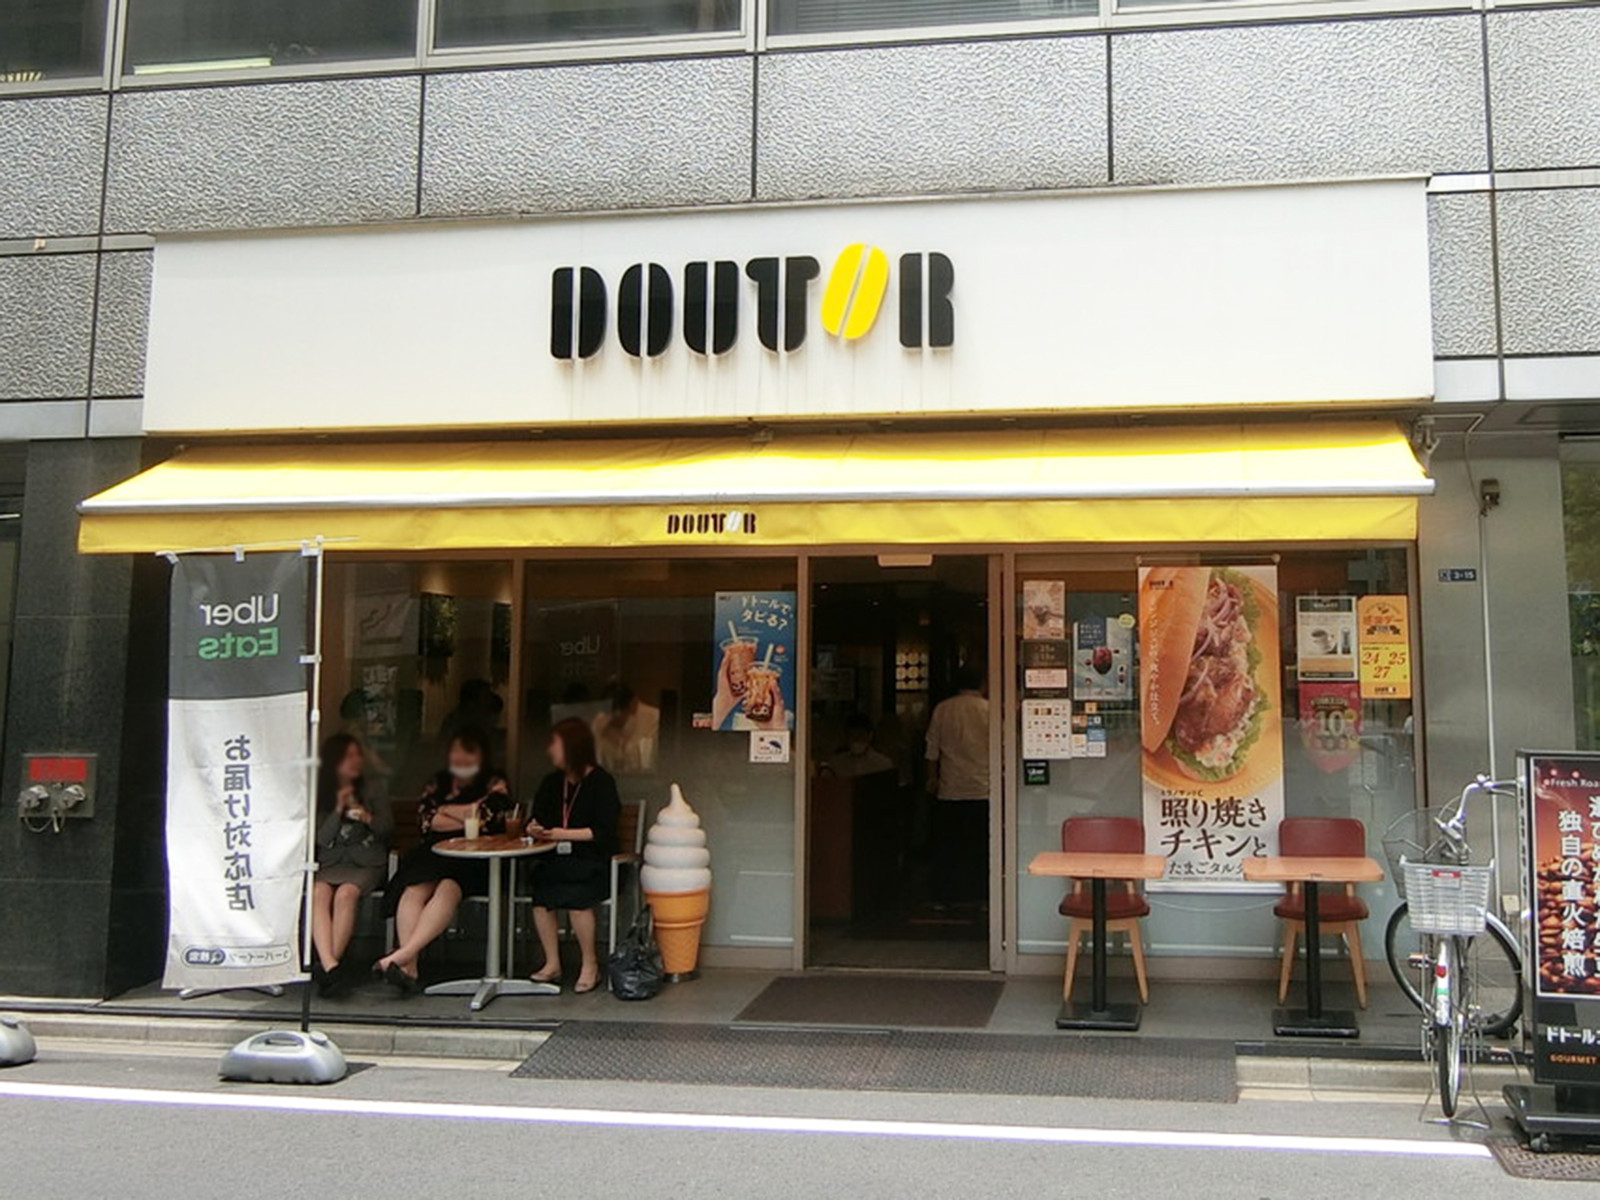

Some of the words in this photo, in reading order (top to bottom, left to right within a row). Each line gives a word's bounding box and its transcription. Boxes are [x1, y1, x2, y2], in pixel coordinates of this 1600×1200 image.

[551, 242, 955, 360] DOUTOR
[667, 511, 757, 535] DOUTOR
[1550, 778, 1578, 788] Fresh
[1579, 779, 1600, 788] Roa
[1160, 796, 1267, 829] 照り焼き
[1160, 828, 1269, 860] チキンと
[1558, 809, 1588, 978] 独自の直火焙煎
[1547, 1026, 1600, 1045] ドトール
[1549, 1054, 1597, 1065] GOURMET
